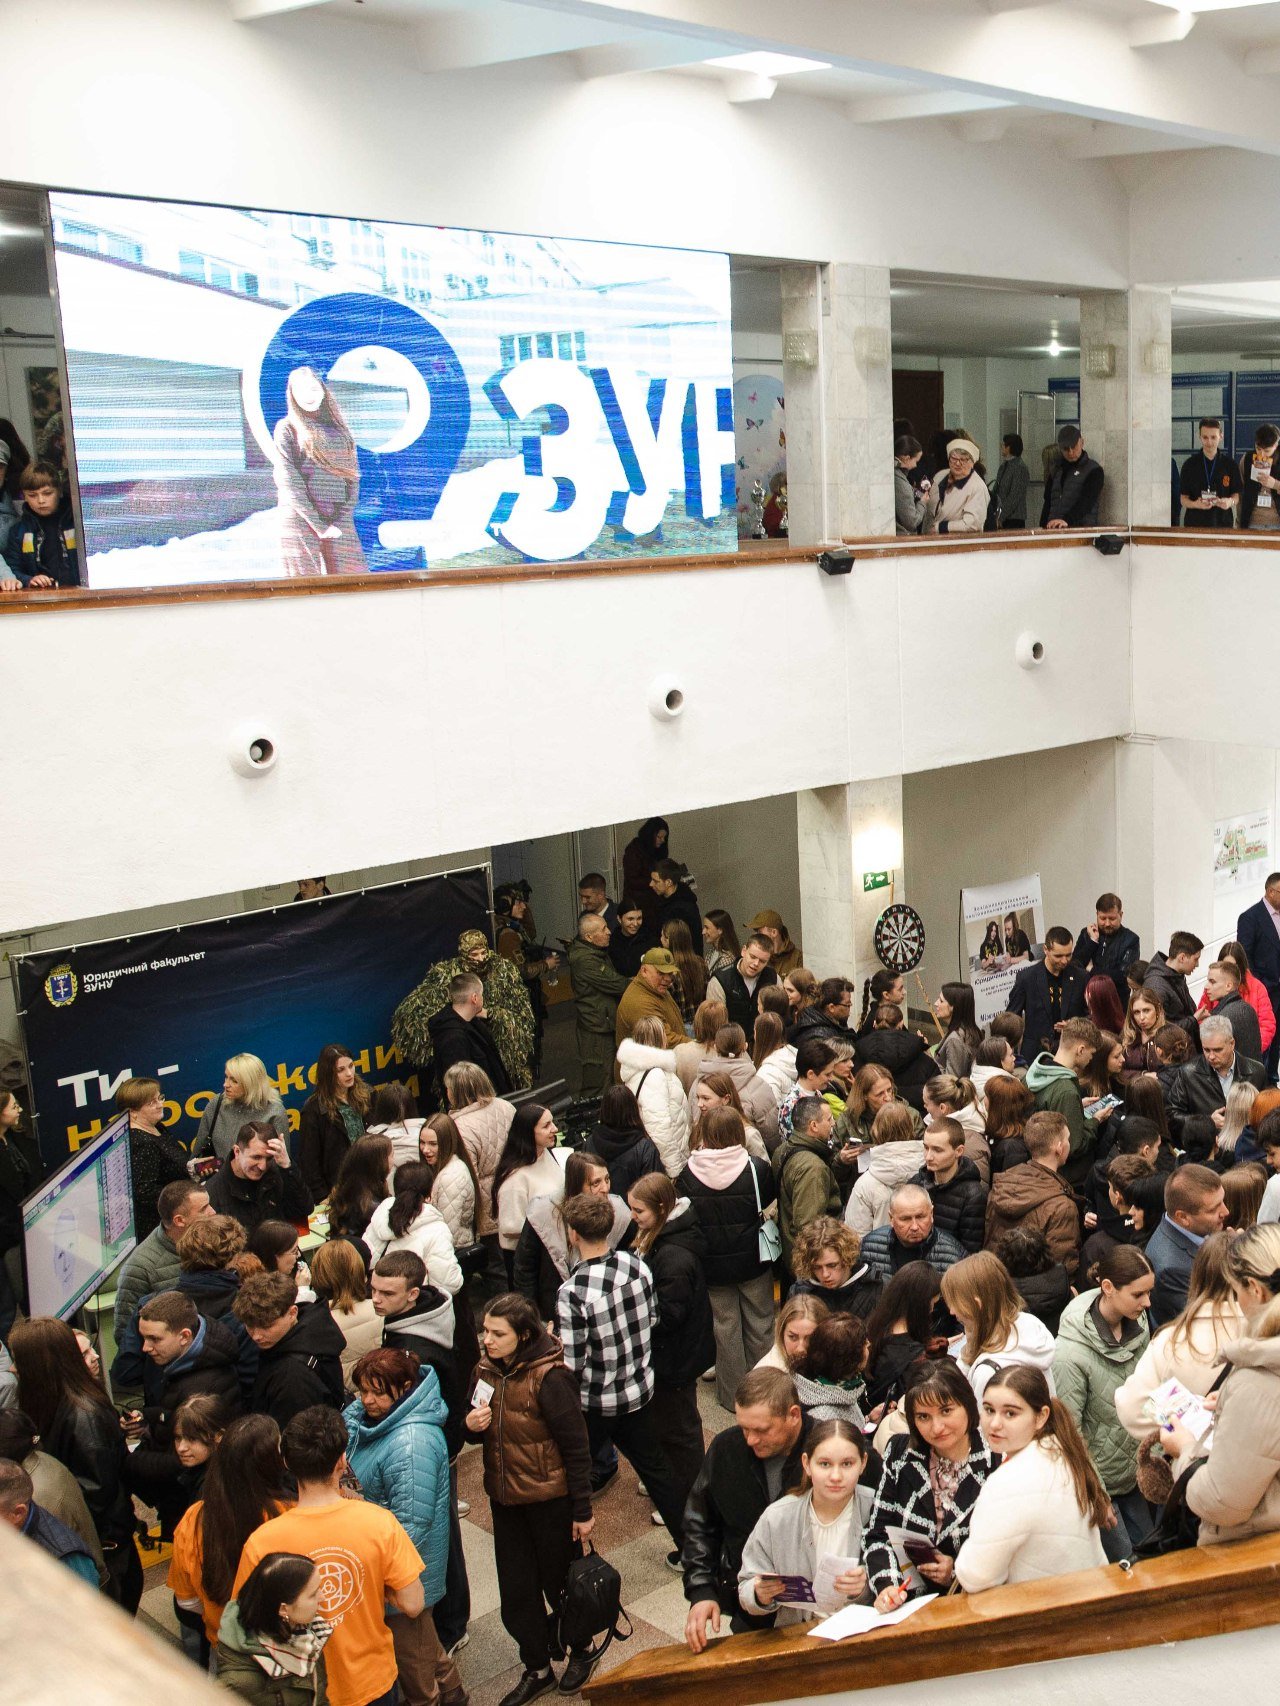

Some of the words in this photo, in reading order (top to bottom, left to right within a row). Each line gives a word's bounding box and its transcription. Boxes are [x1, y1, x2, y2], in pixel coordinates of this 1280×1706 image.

[83, 962, 148, 983] Юридичний
[150, 951, 206, 970] факультет
[83, 979, 114, 993] ЗУНУ
